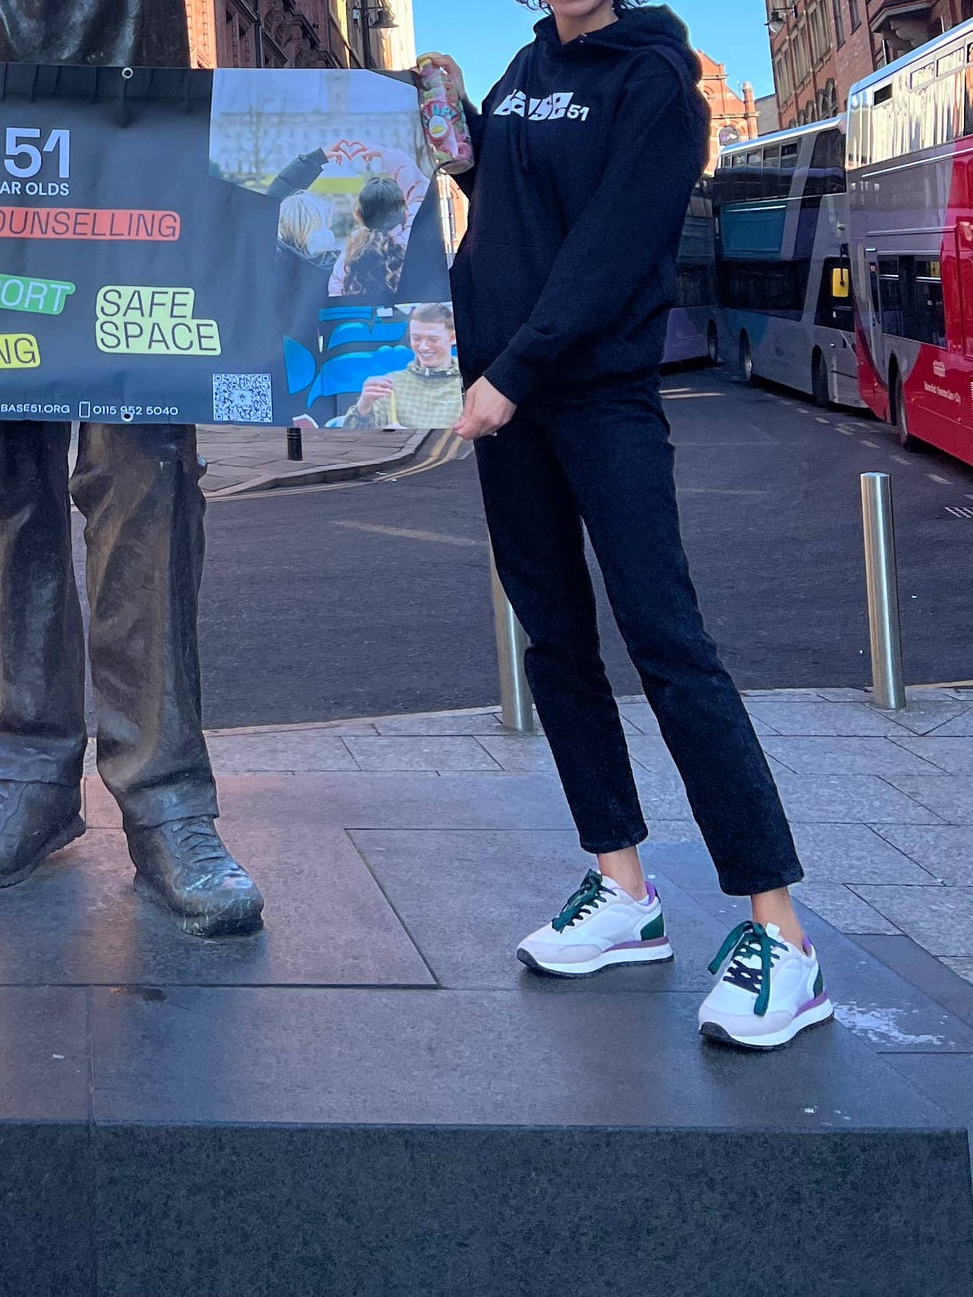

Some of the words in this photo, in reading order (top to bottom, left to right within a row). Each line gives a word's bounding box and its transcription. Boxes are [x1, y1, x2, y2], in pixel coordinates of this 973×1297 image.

[25, 182, 70, 196] OLDS
[100, 289, 190, 318] SAFE
[99, 320, 217, 351] SPACE
[92, 405, 117, 415] 0115
[120, 405, 143, 415] 952
[146, 406, 179, 416] 5040
